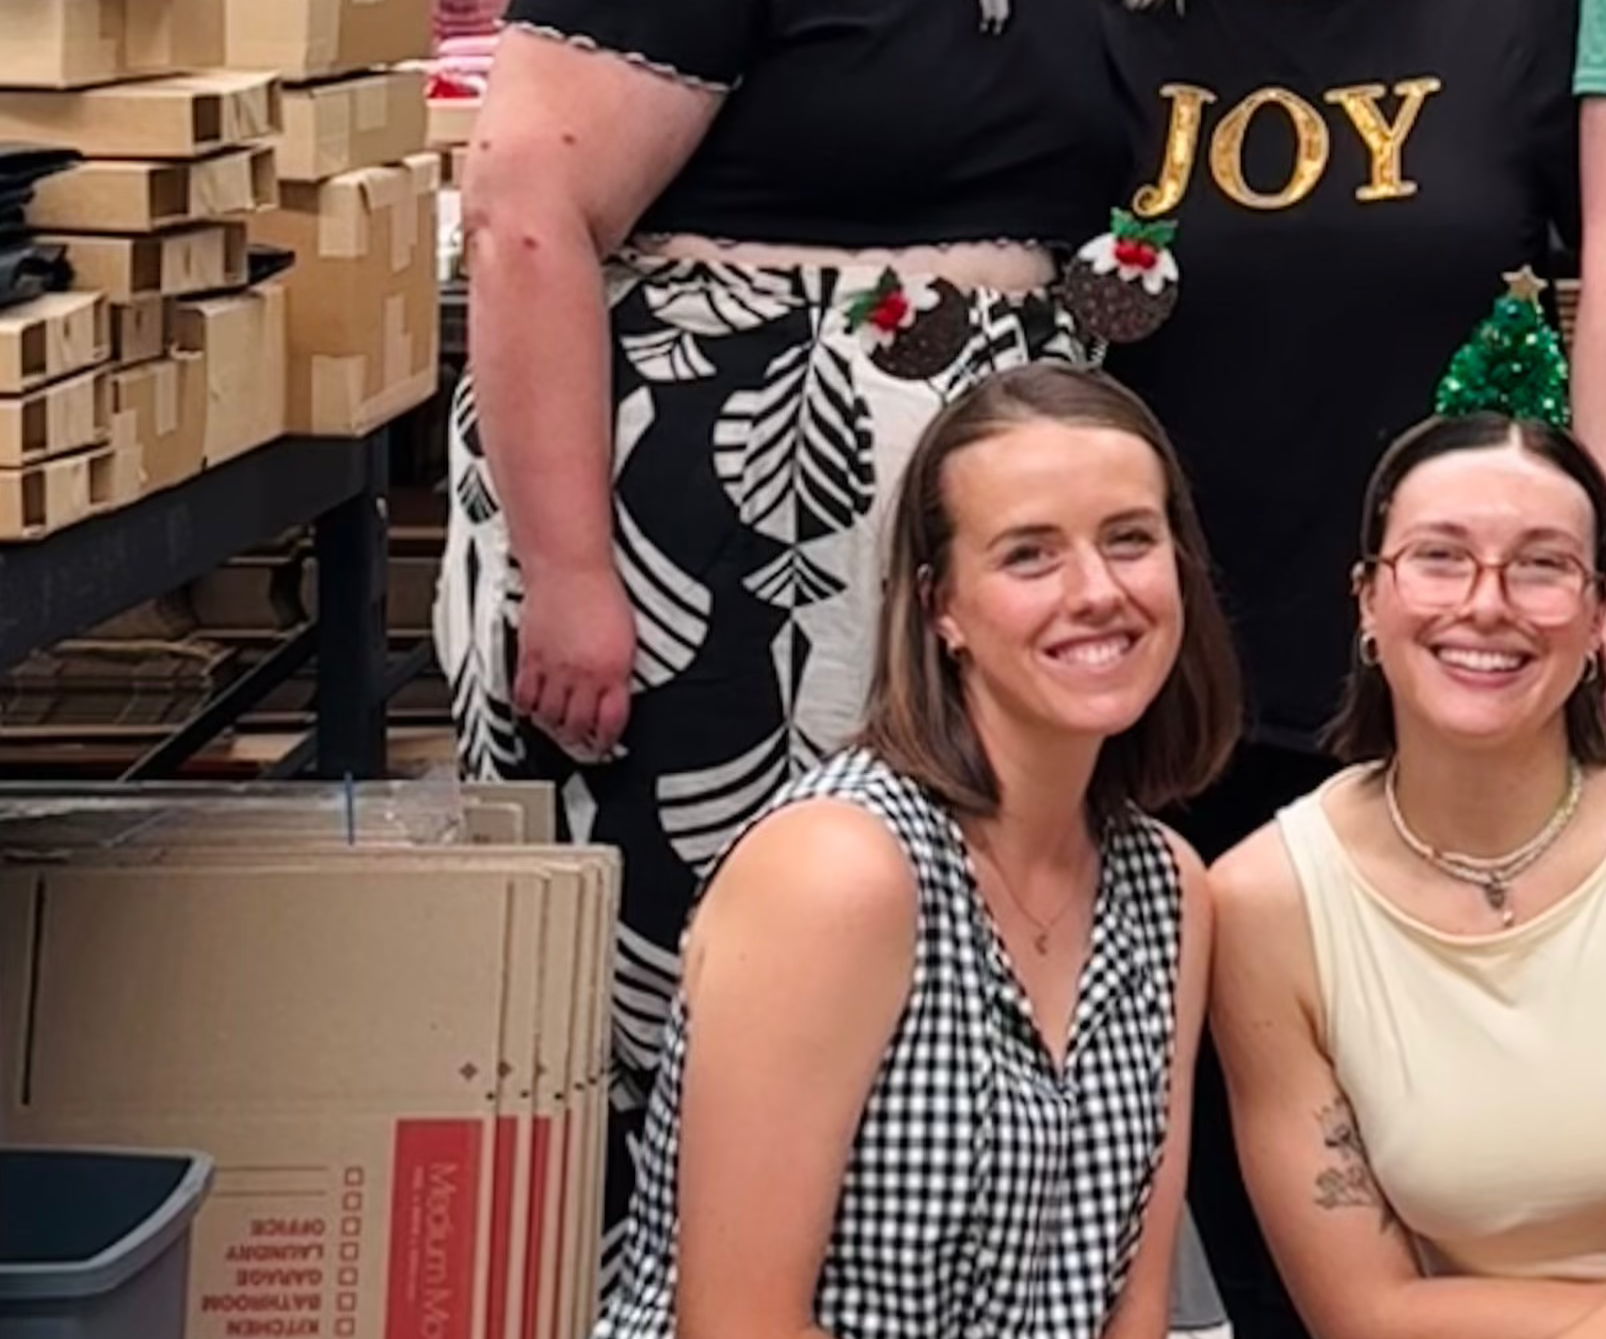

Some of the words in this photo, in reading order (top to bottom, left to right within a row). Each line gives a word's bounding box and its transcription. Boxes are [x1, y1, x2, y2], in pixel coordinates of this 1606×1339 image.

[1131, 75, 1442, 218] JOY
[249, 1218, 326, 1236] OFFICE
[225, 1244, 324, 1262] LAUNDRY
[235, 1269, 323, 1286] GARAGE
[201, 1294, 321, 1312] BATHROOM
[225, 1319, 320, 1336] KITCHEN
